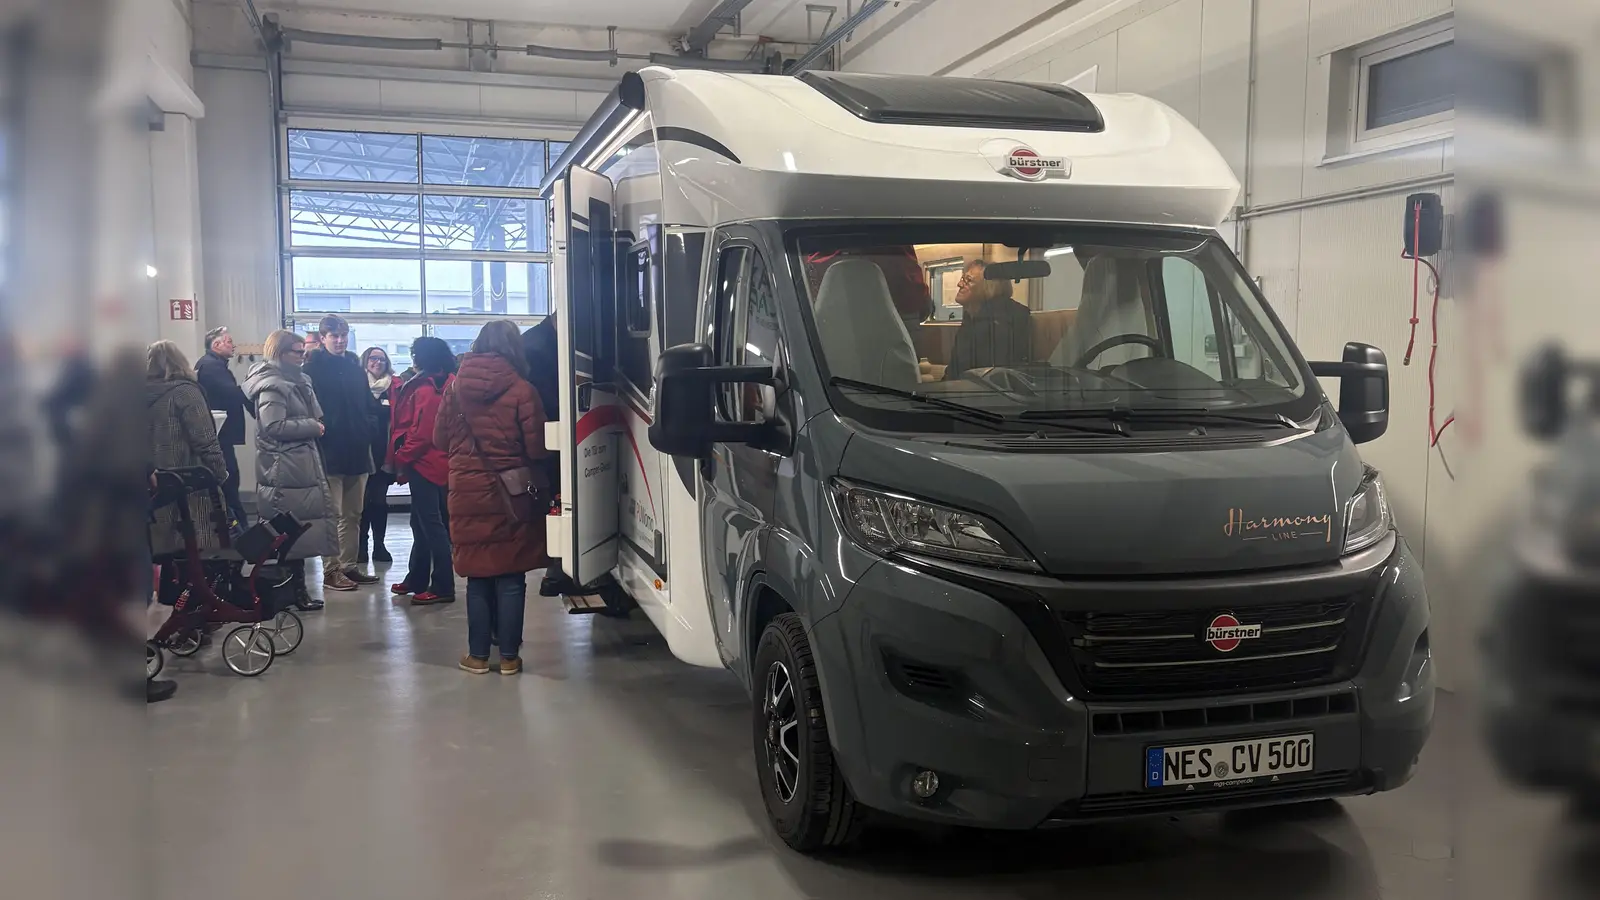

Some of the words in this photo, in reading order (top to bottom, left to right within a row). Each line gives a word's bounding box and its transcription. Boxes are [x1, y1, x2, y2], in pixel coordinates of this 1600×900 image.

[1009, 157, 1061, 167] bürstner
[1223, 508, 1331, 543] Harmony
[1271, 531, 1298, 541] LINE
[1207, 628, 1260, 639] bürstner
[1164, 748, 1213, 781] NES
[1232, 743, 1262, 774] CV
[1268, 738, 1311, 770] 500
[1152, 771, 1159, 781] D
